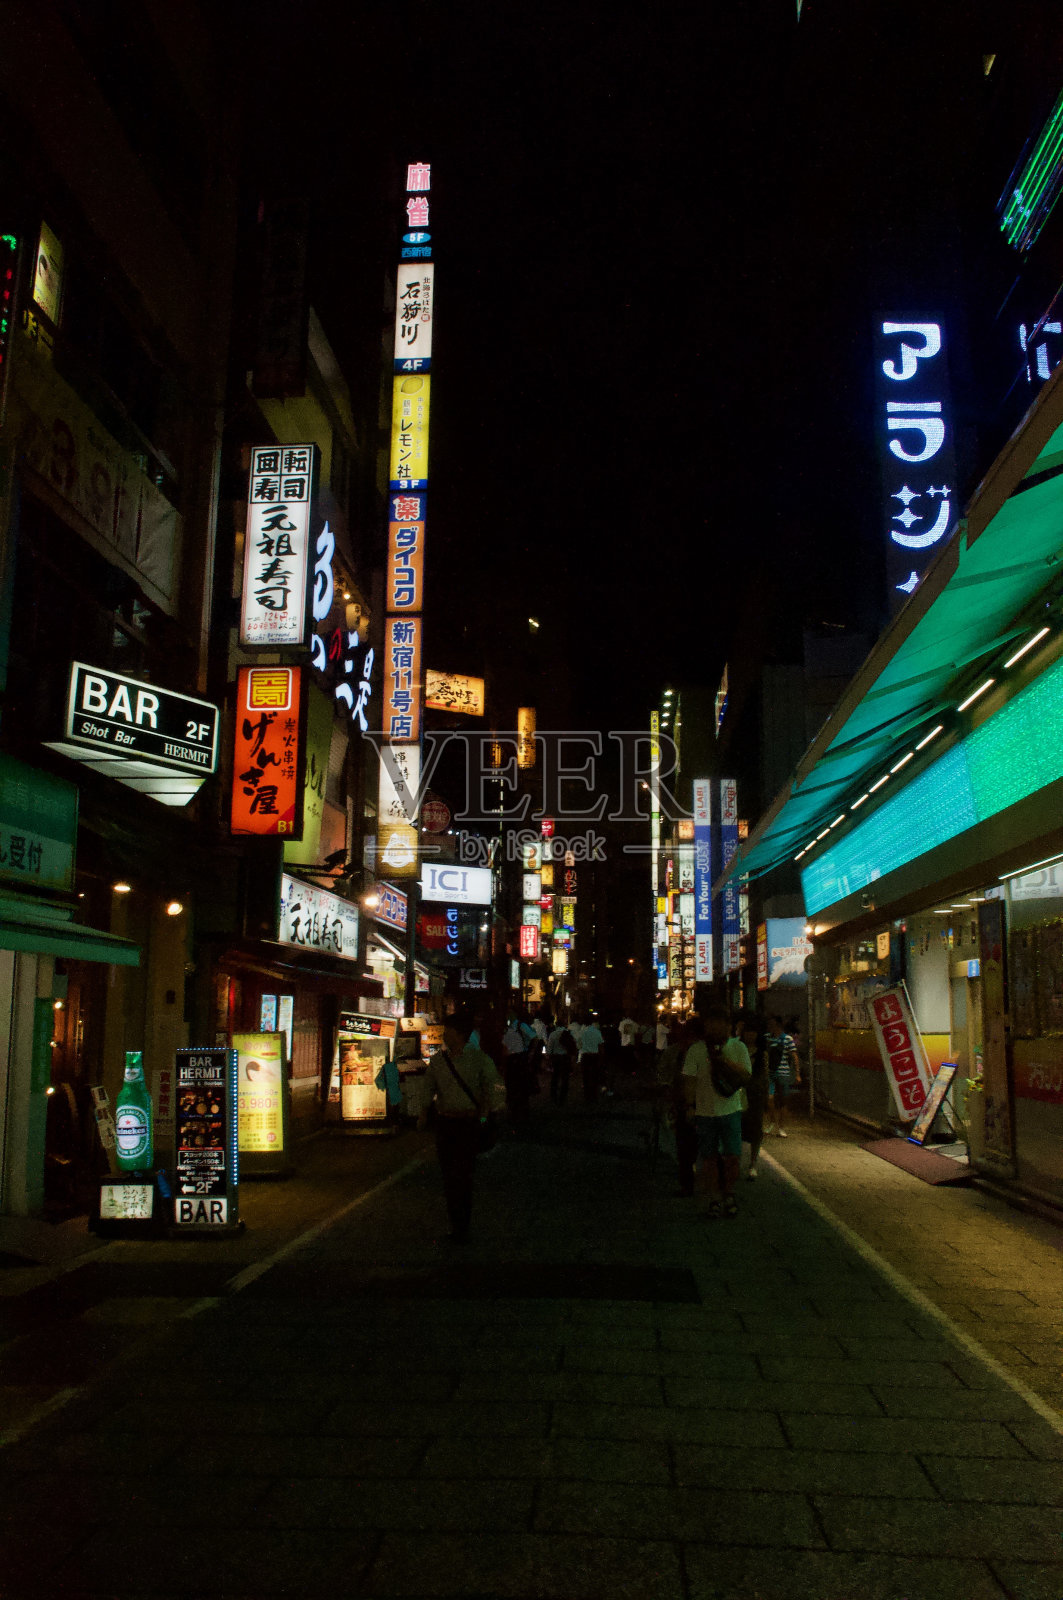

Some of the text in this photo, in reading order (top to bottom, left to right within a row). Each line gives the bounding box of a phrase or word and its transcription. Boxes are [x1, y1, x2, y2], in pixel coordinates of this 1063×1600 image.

[407, 162, 431, 227] 麻雀
[409, 232, 425, 242] 5F
[402, 360, 423, 371] 4F
[397, 418, 413, 479] レモン社
[400, 480, 420, 489] 3F
[255, 505, 297, 612] 元祖寿司
[394, 526, 419, 608] ダイコク
[82, 674, 211, 741] BAR 2F
[81, 721, 137, 745] Shot Bar
[164, 742, 209, 764] HERMIT
[239, 713, 283, 816] げんき屋
[278, 819, 294, 833] B1
[430, 868, 468, 891] ICI
[190, 1056, 213, 1067] BAR
[880, 1000, 921, 1105] ようこそ
[180, 1067, 222, 1079] HERMIT
[196, 1182, 213, 1194] 2F
[180, 1200, 224, 1223] BAR
